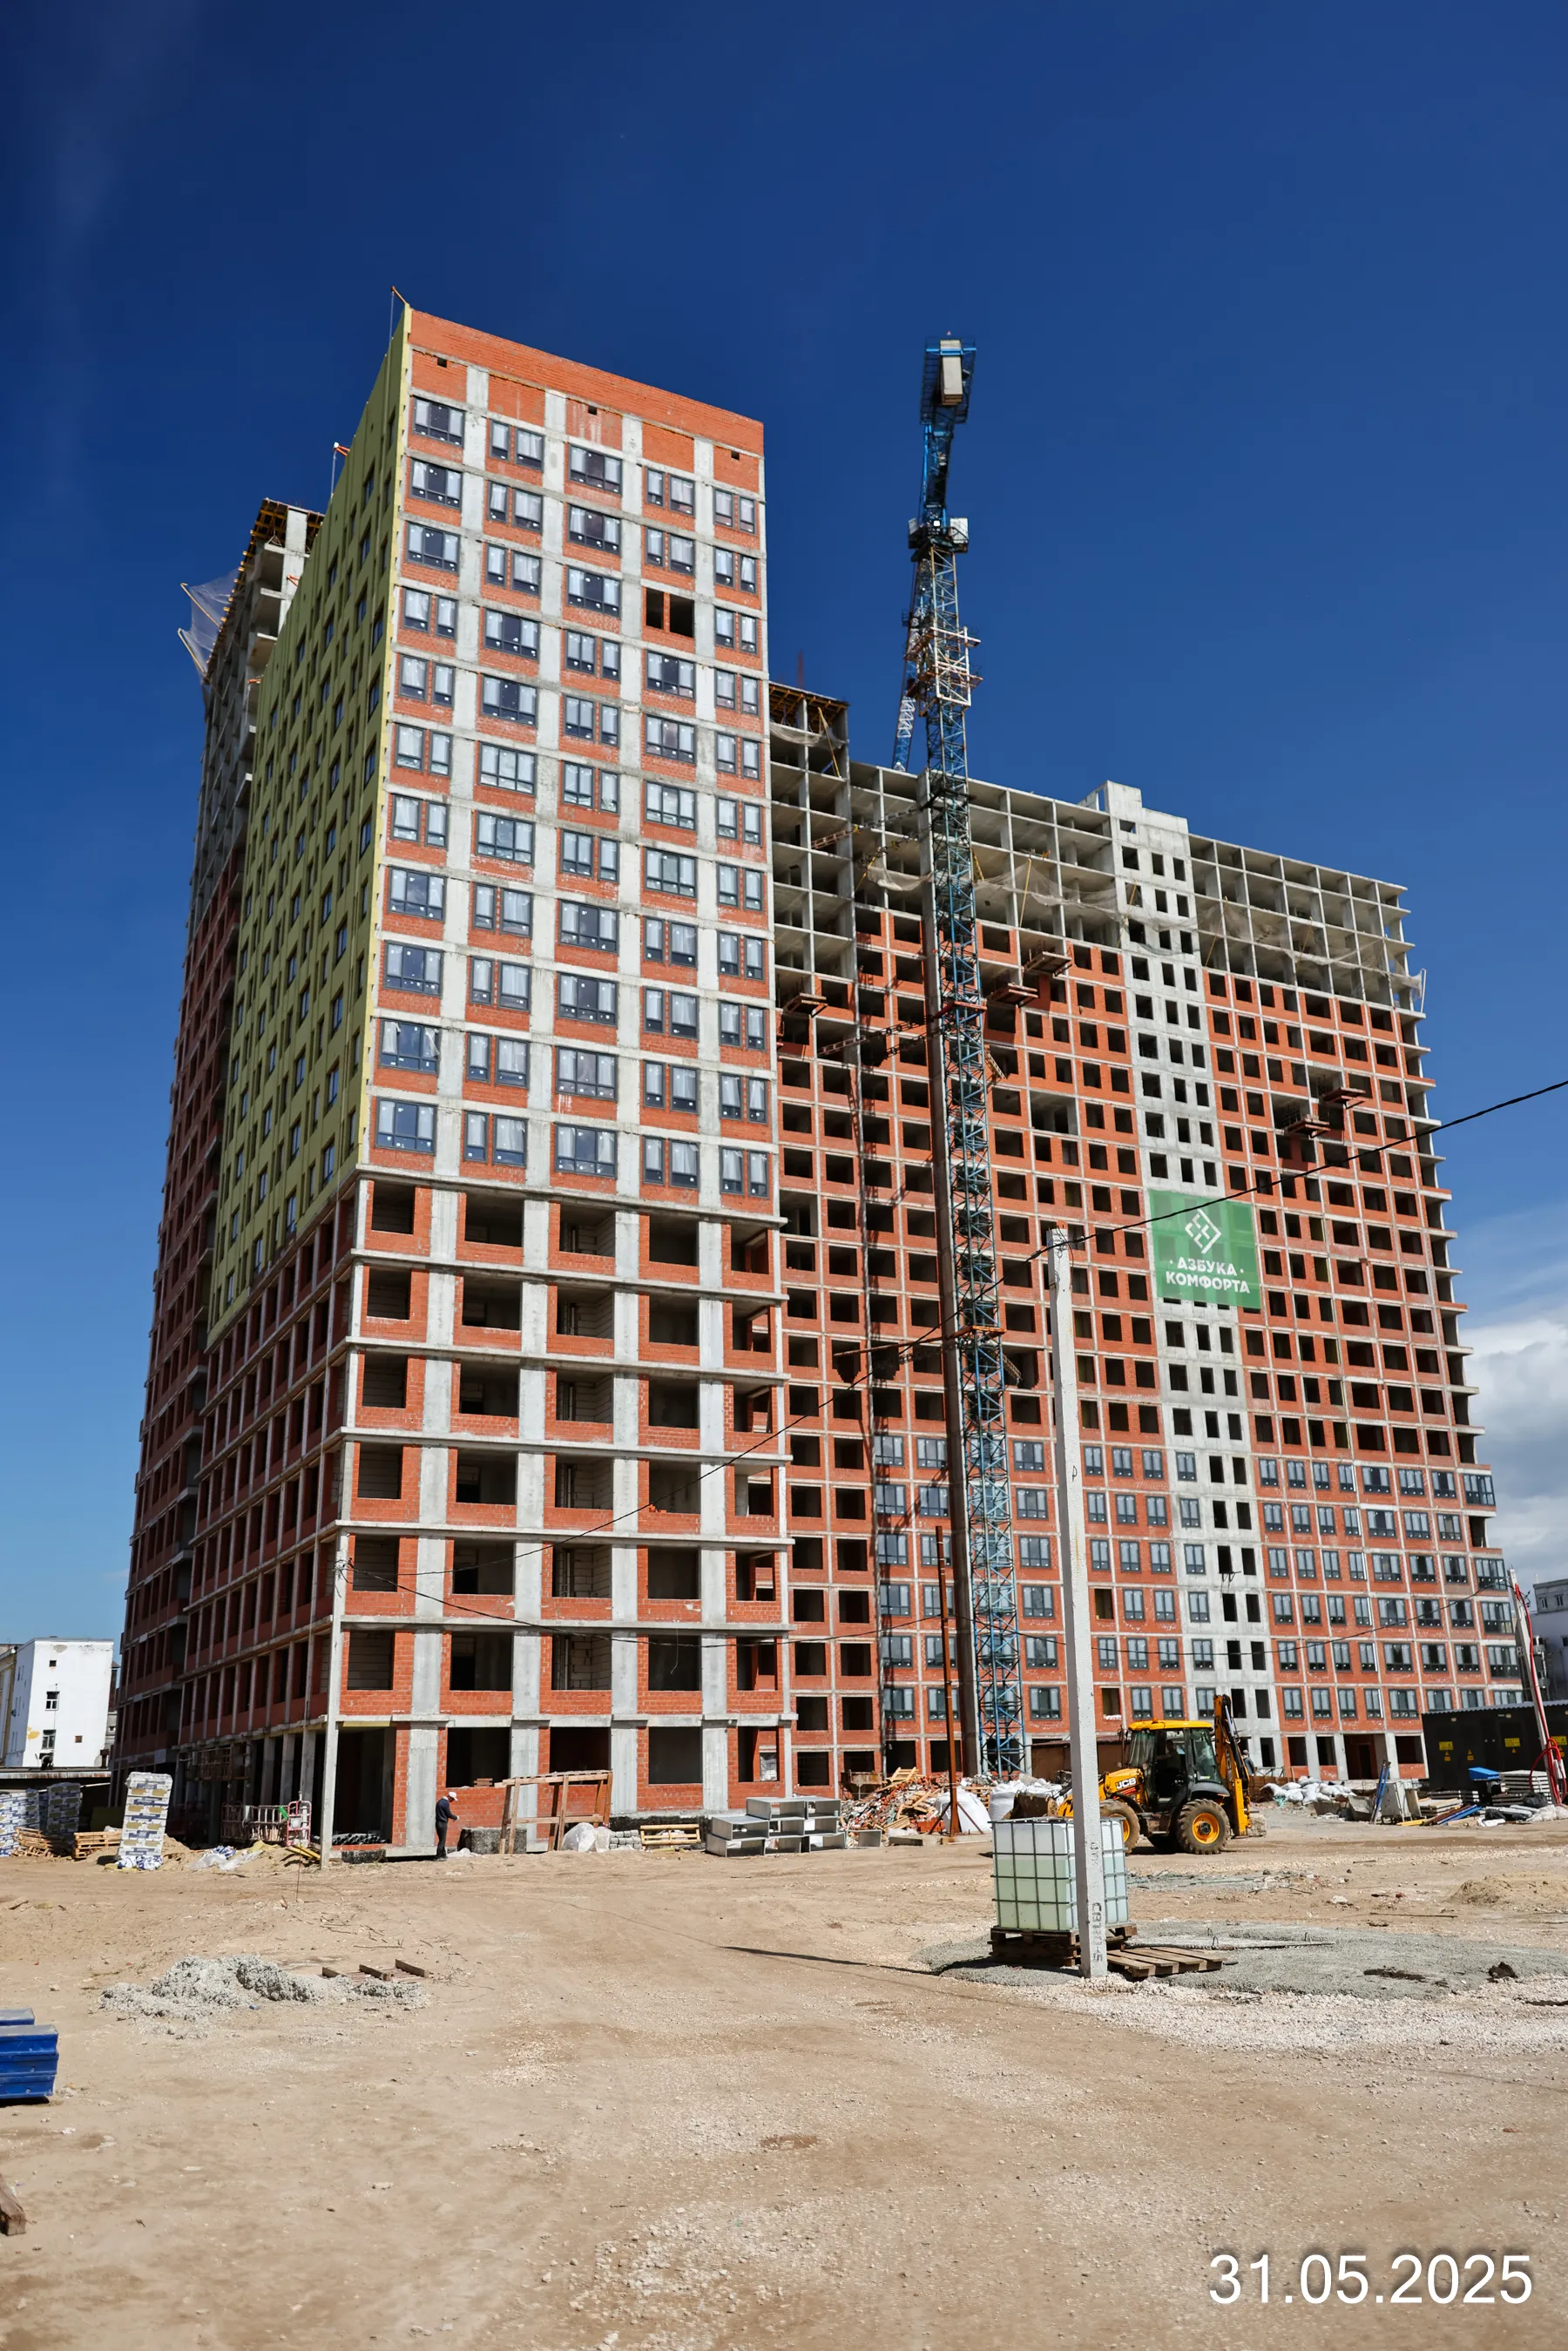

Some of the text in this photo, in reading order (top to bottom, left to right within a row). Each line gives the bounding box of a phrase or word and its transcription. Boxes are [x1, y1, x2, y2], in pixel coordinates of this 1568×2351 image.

[1178, 1257, 1238, 1276] АЗБУКА
[1166, 1271, 1250, 1294] КОМФОРТА
[1116, 1777, 1137, 1790] JCB
